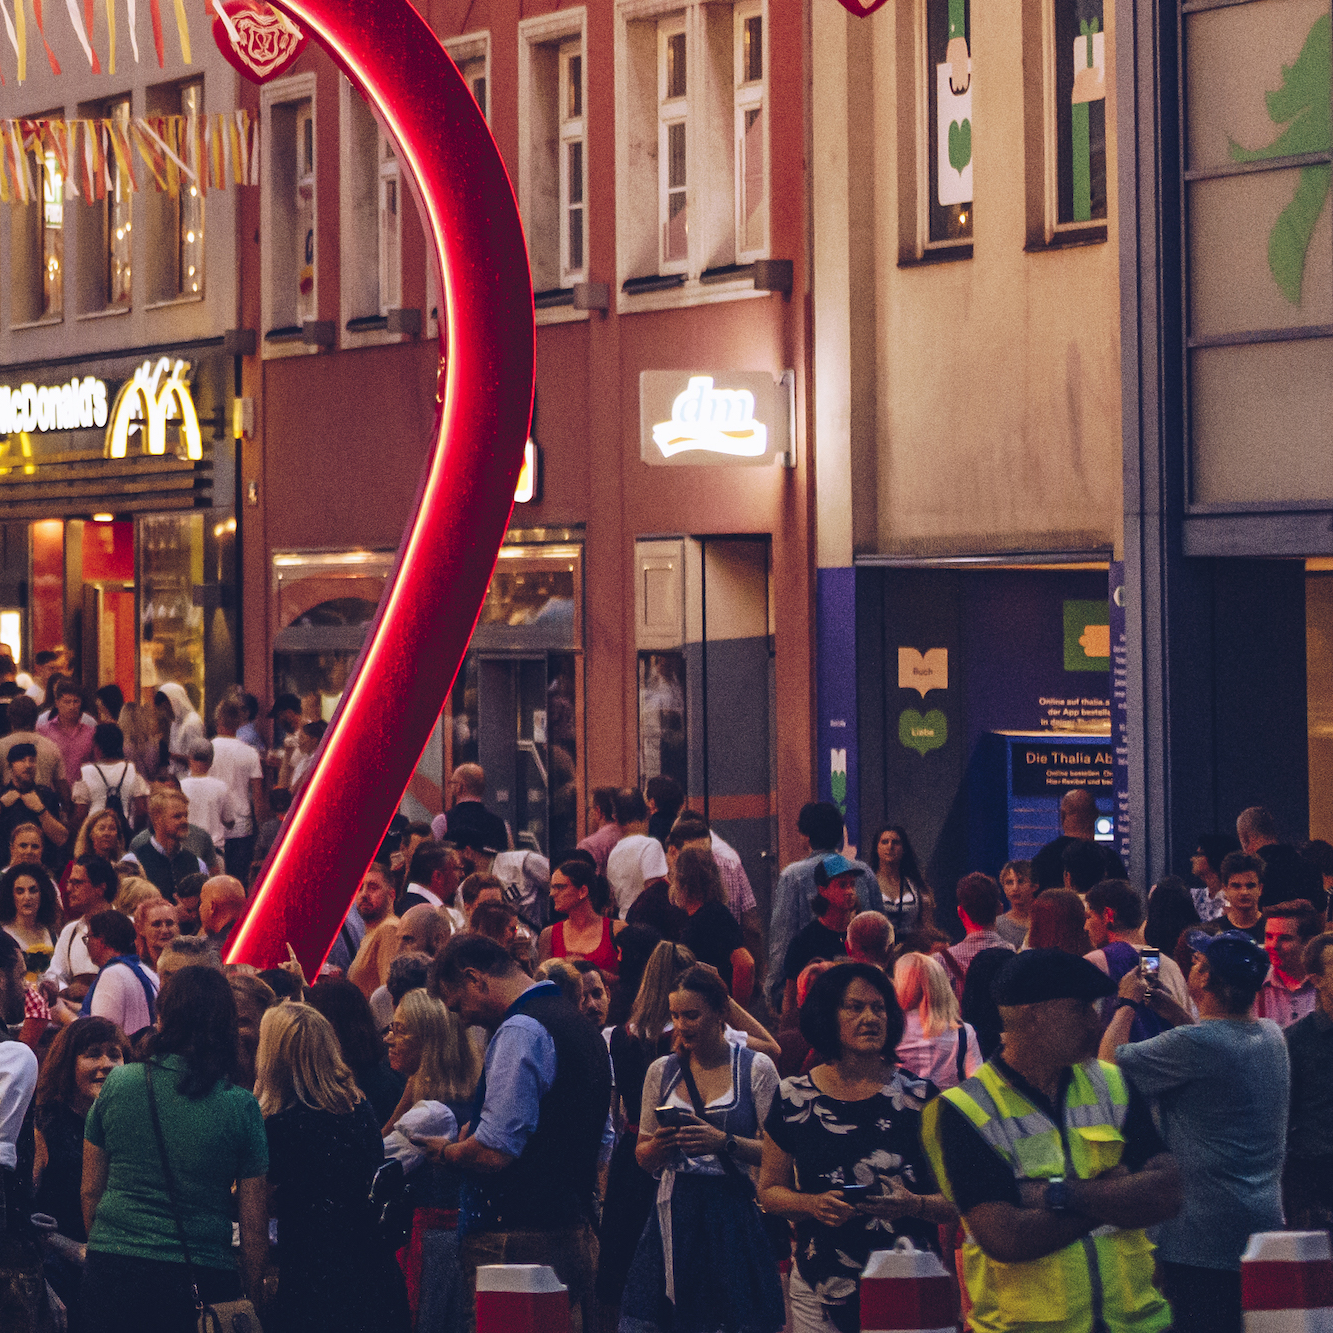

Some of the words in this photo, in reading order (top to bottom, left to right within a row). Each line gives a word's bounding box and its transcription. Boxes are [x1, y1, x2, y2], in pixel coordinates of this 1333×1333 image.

[679, 385, 747, 423] dm
[913, 667, 933, 676] Buch
[1063, 708, 1080, 718] App
[1026, 752, 1048, 764] Die
[1051, 752, 1091, 764] Thalia
